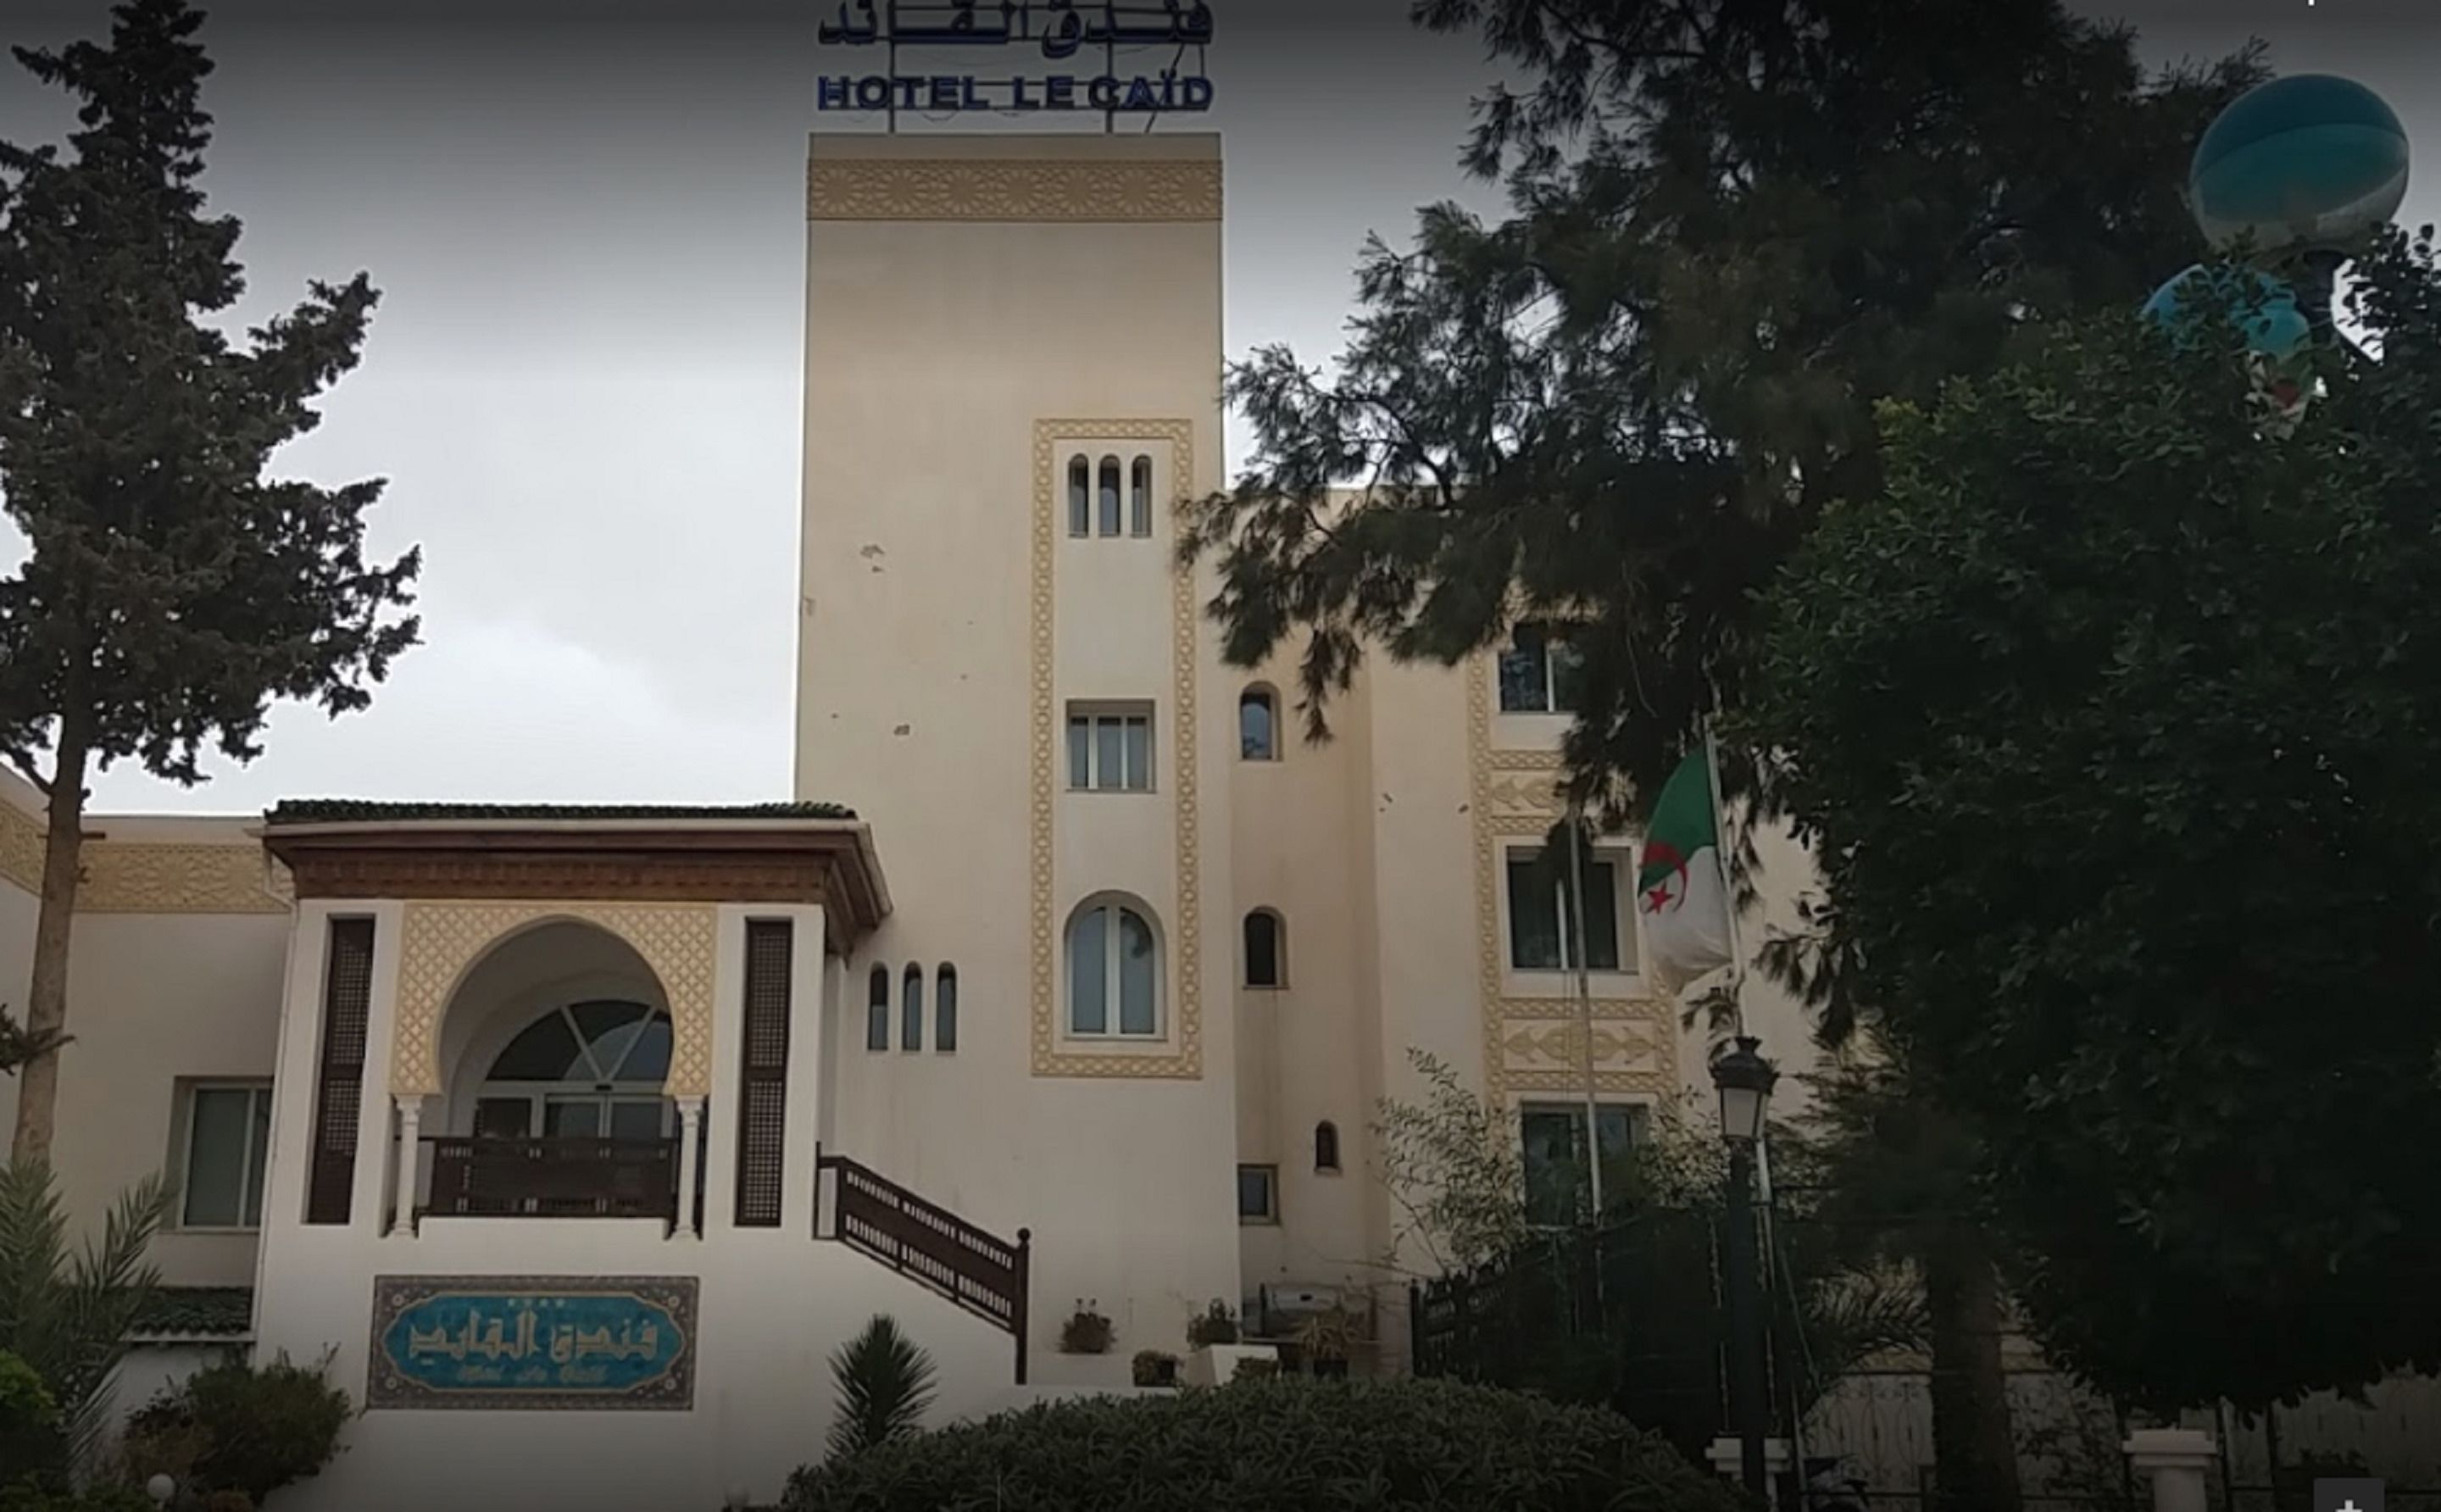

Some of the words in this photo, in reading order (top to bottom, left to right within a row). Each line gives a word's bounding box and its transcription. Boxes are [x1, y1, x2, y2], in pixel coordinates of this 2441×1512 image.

[818, 75, 989, 111] HOTEL
[1015, 75, 1076, 111] LE
[1087, 69, 1215, 111] CAÏD
[550, 1317, 659, 1363] فندق
